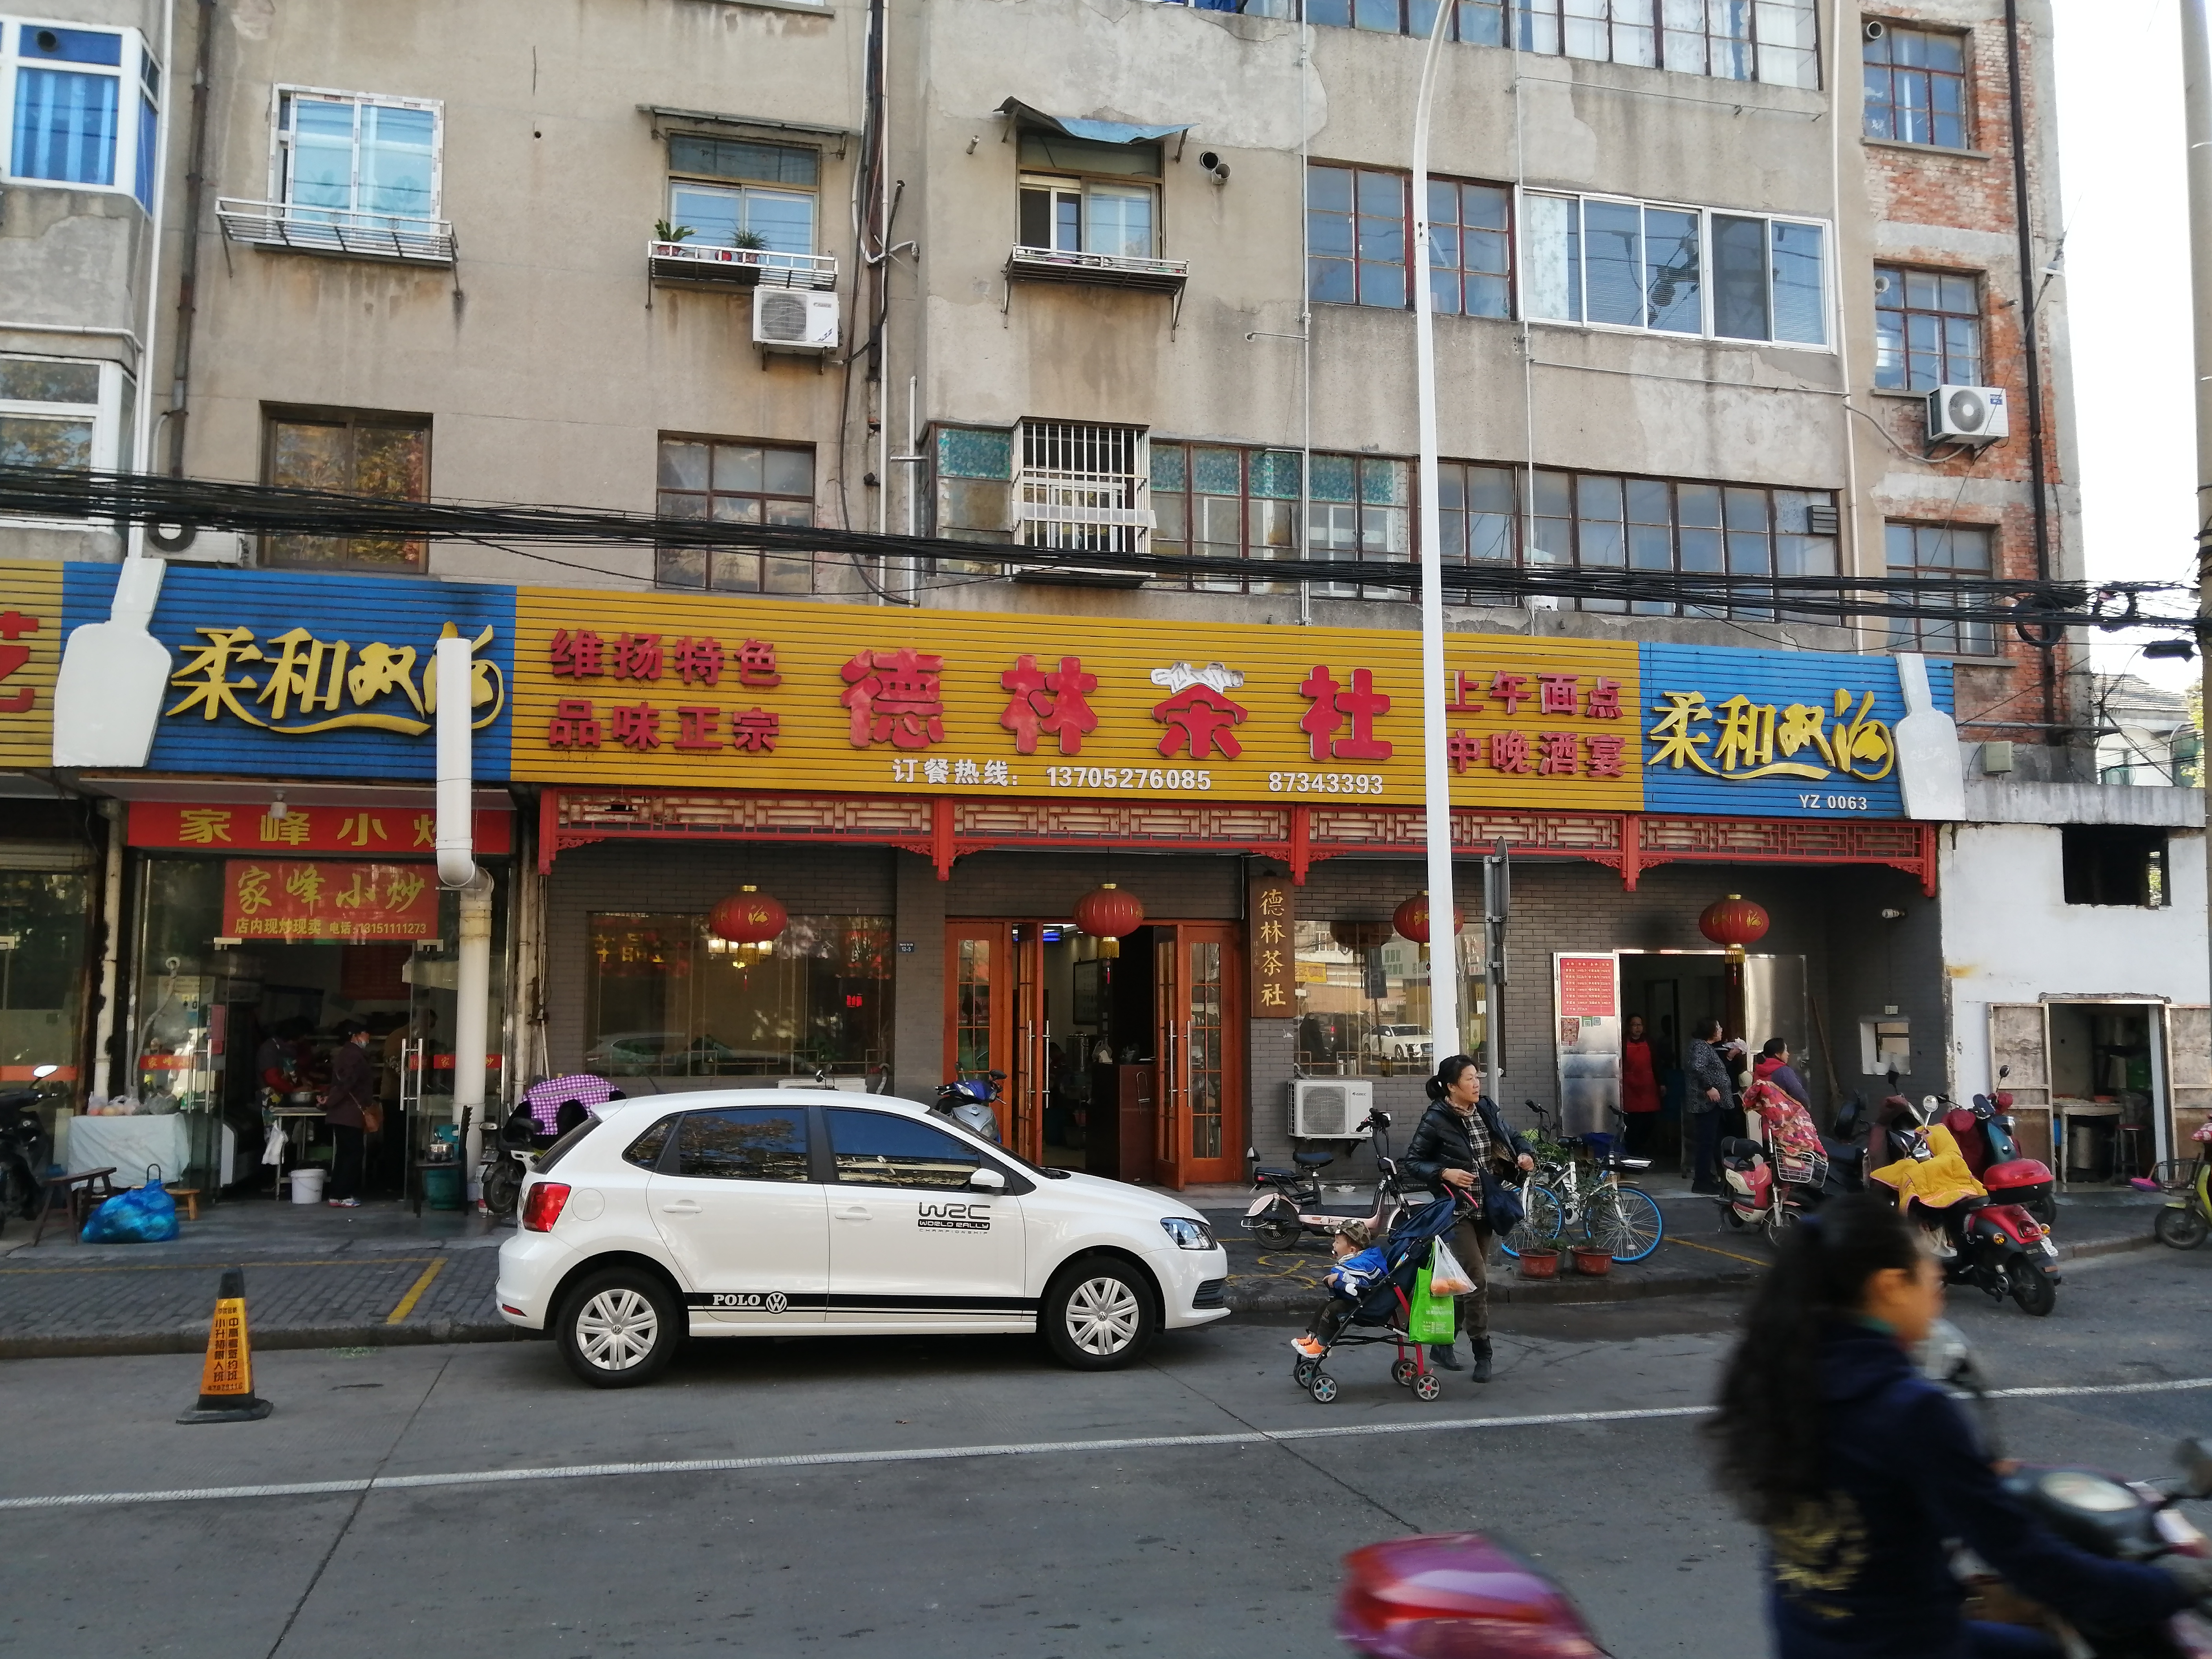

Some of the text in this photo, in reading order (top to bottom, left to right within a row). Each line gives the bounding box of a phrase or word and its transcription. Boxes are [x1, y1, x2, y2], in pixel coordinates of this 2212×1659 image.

[550, 628, 782, 687] 维扬特色
[1447, 670, 1624, 720] 上午面点
[549, 699, 780, 752] 品味正宗
[1447, 729, 1626, 778] 中晚酒宴
[1046, 766, 1211, 791] 13705276085
[1269, 772, 1384, 794] 87343393
[1799, 793, 1868, 811] YZ 0063
[238, 865, 426, 916] 家峰小炒
[234, 917, 321, 935] 店内现炒现卖
[1259, 888, 1286, 1007] 德林茶社
[712, 1294, 761, 1306] POLO
